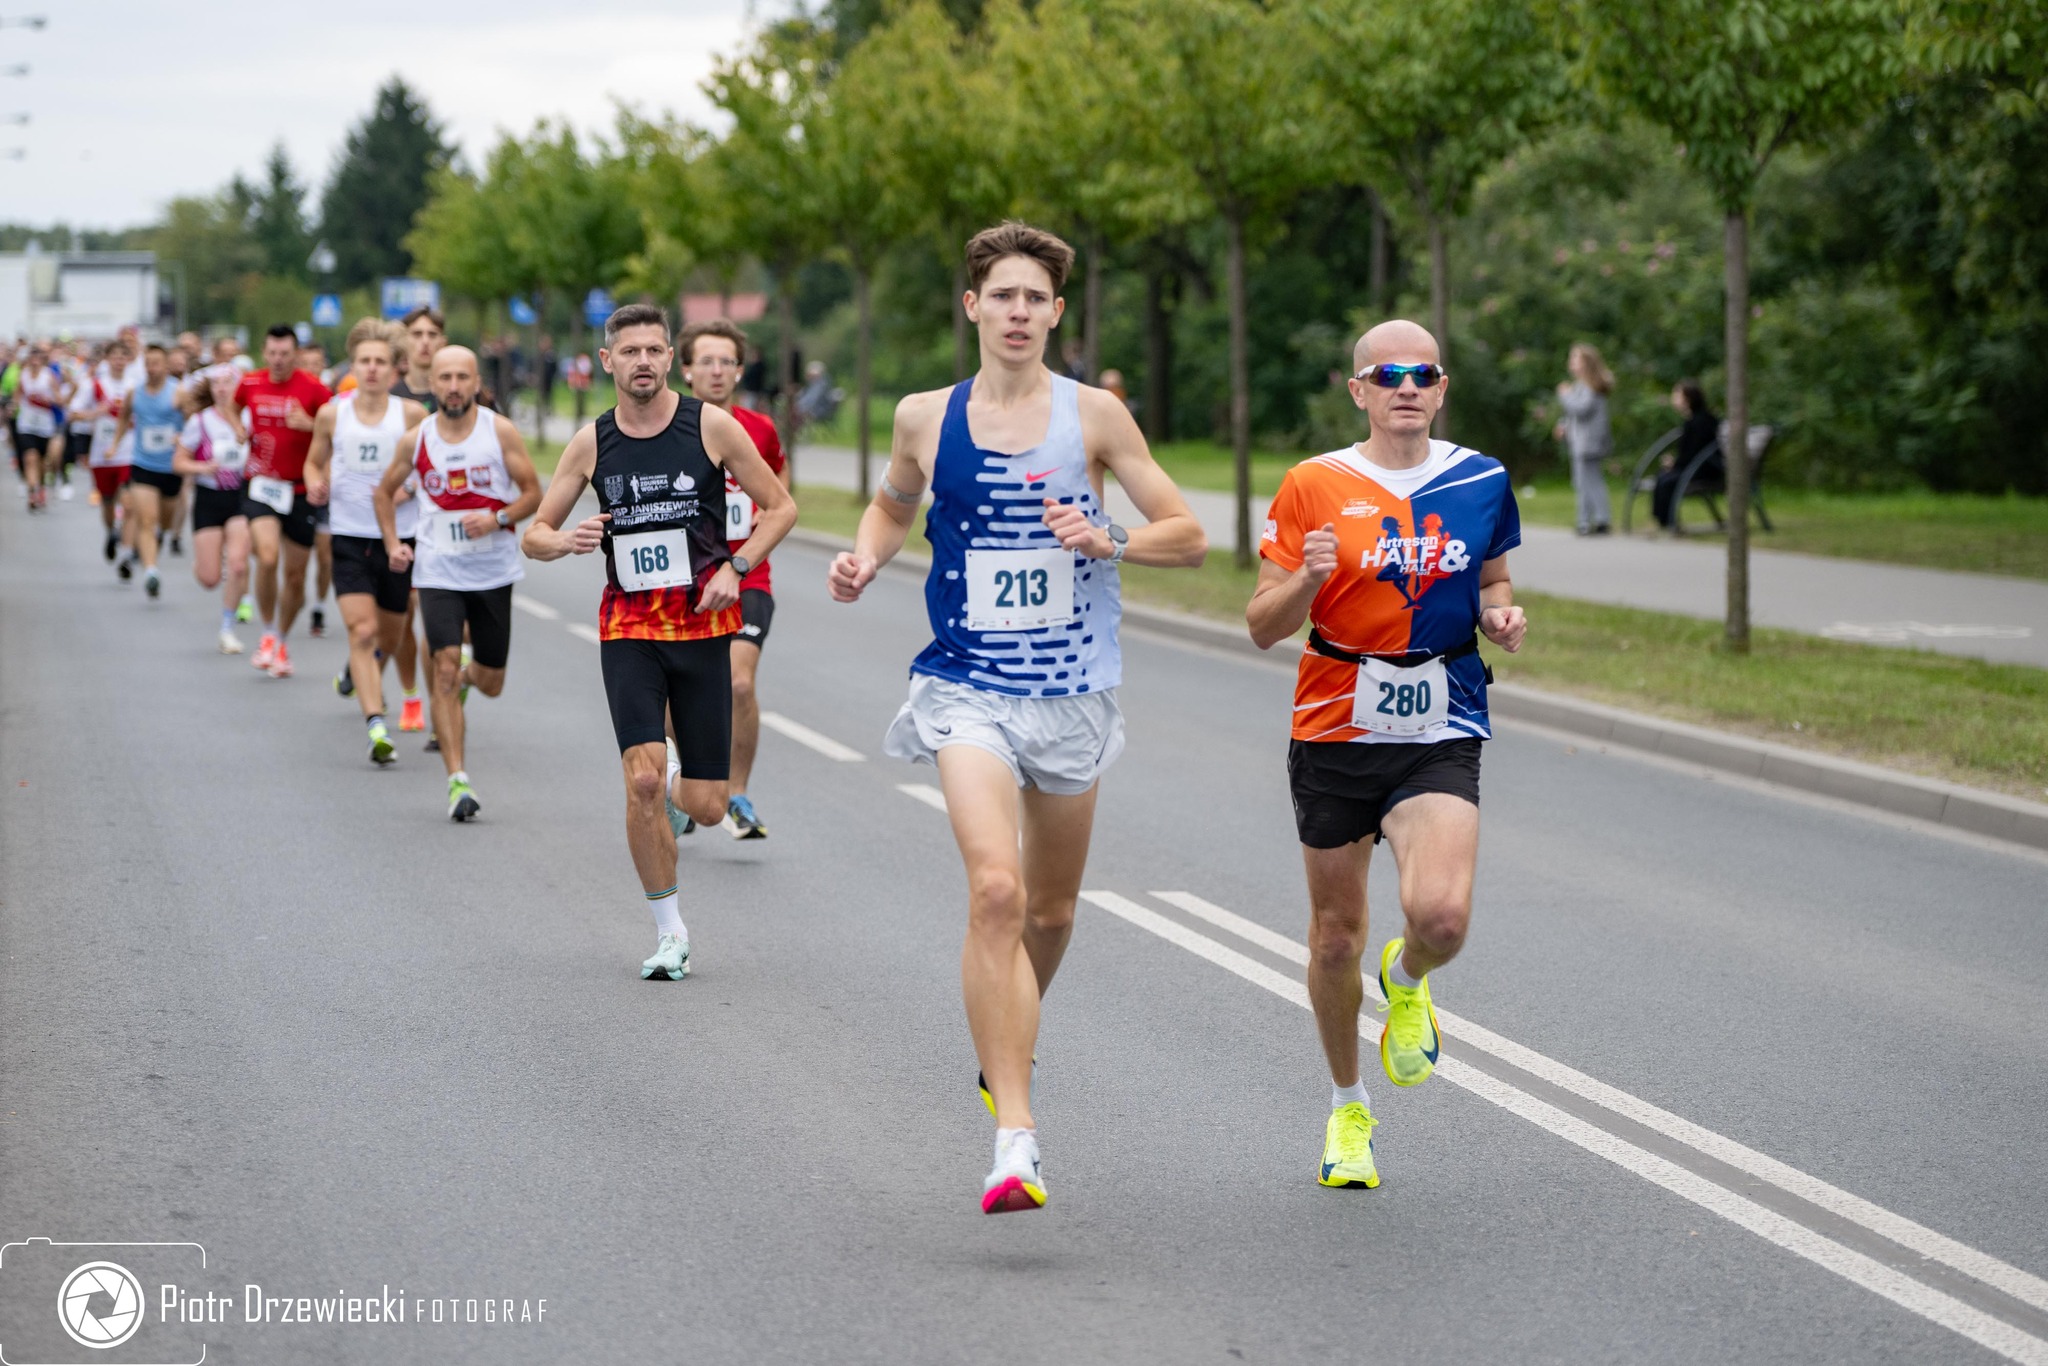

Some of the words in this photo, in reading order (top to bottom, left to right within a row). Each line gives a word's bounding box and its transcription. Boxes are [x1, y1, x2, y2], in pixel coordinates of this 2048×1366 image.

[359, 443, 378, 462] 22
[726, 504, 741, 525] 0
[1376, 536, 1439, 550] Artresan
[630, 545, 669, 574] 168
[1361, 545, 1438, 568] HALF
[1438, 539, 1471, 573] &
[1399, 562, 1437, 573] HALF
[994, 568, 1048, 607] 213
[1376, 680, 1431, 717] 280
